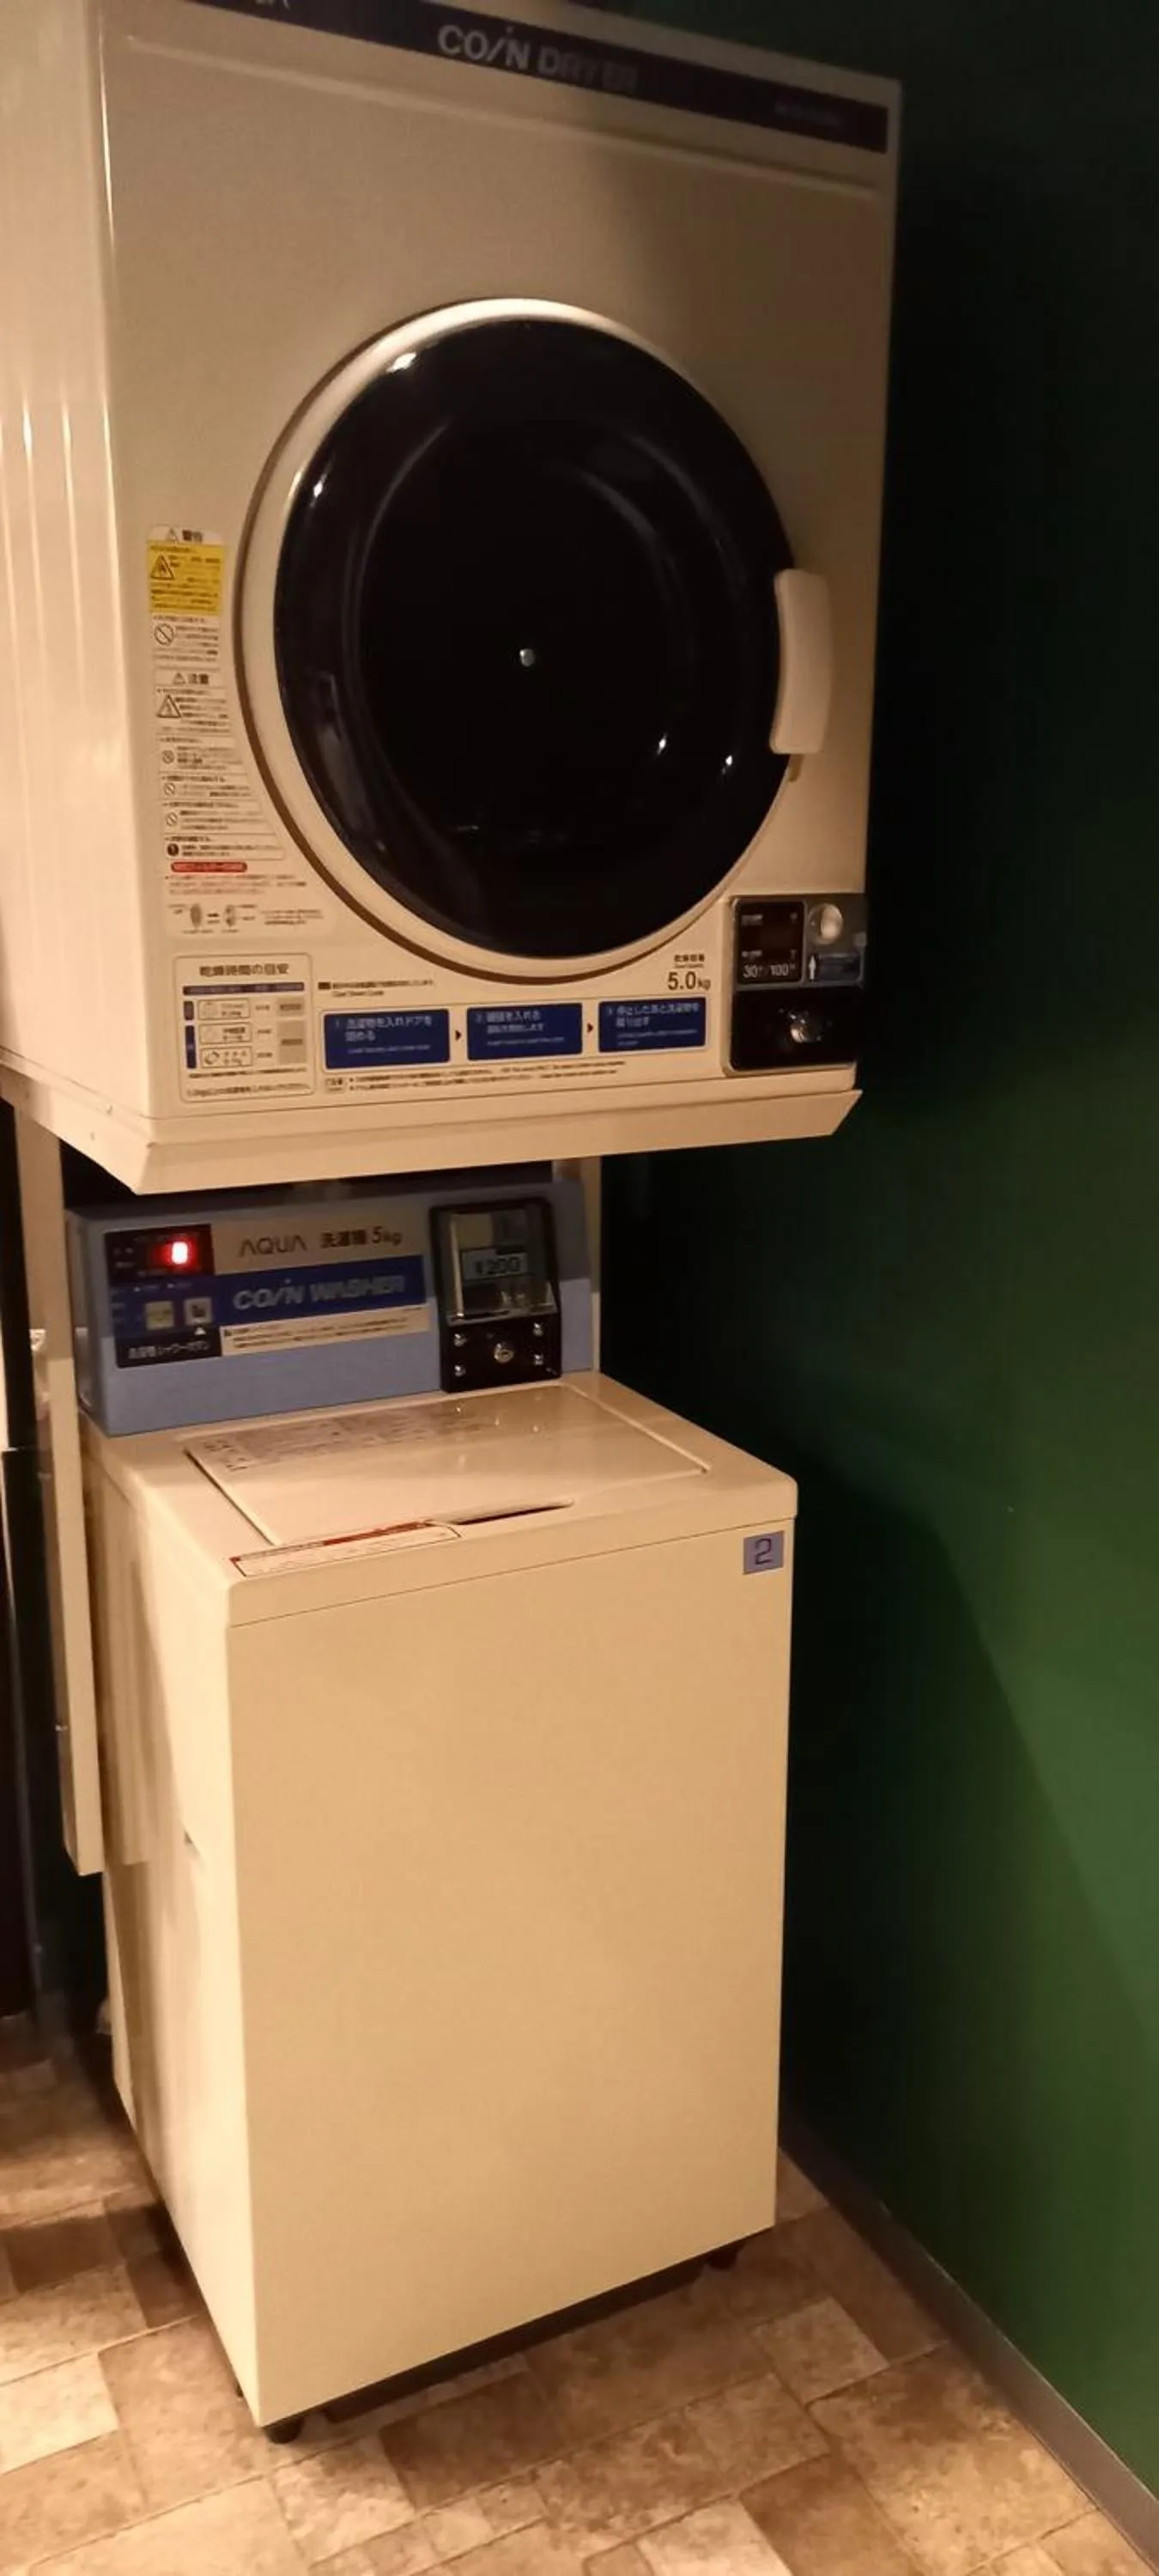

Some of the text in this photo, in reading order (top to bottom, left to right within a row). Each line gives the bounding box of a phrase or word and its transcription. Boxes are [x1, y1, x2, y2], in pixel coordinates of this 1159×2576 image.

[438, 25, 638, 91] COIN DRYER
[240, 1235, 309, 1258] AQUA
[319, 1229, 367, 1250] 洗濯機
[234, 1275, 405, 1310] COIN WASHER
[755, 1538, 773, 1565] 2
